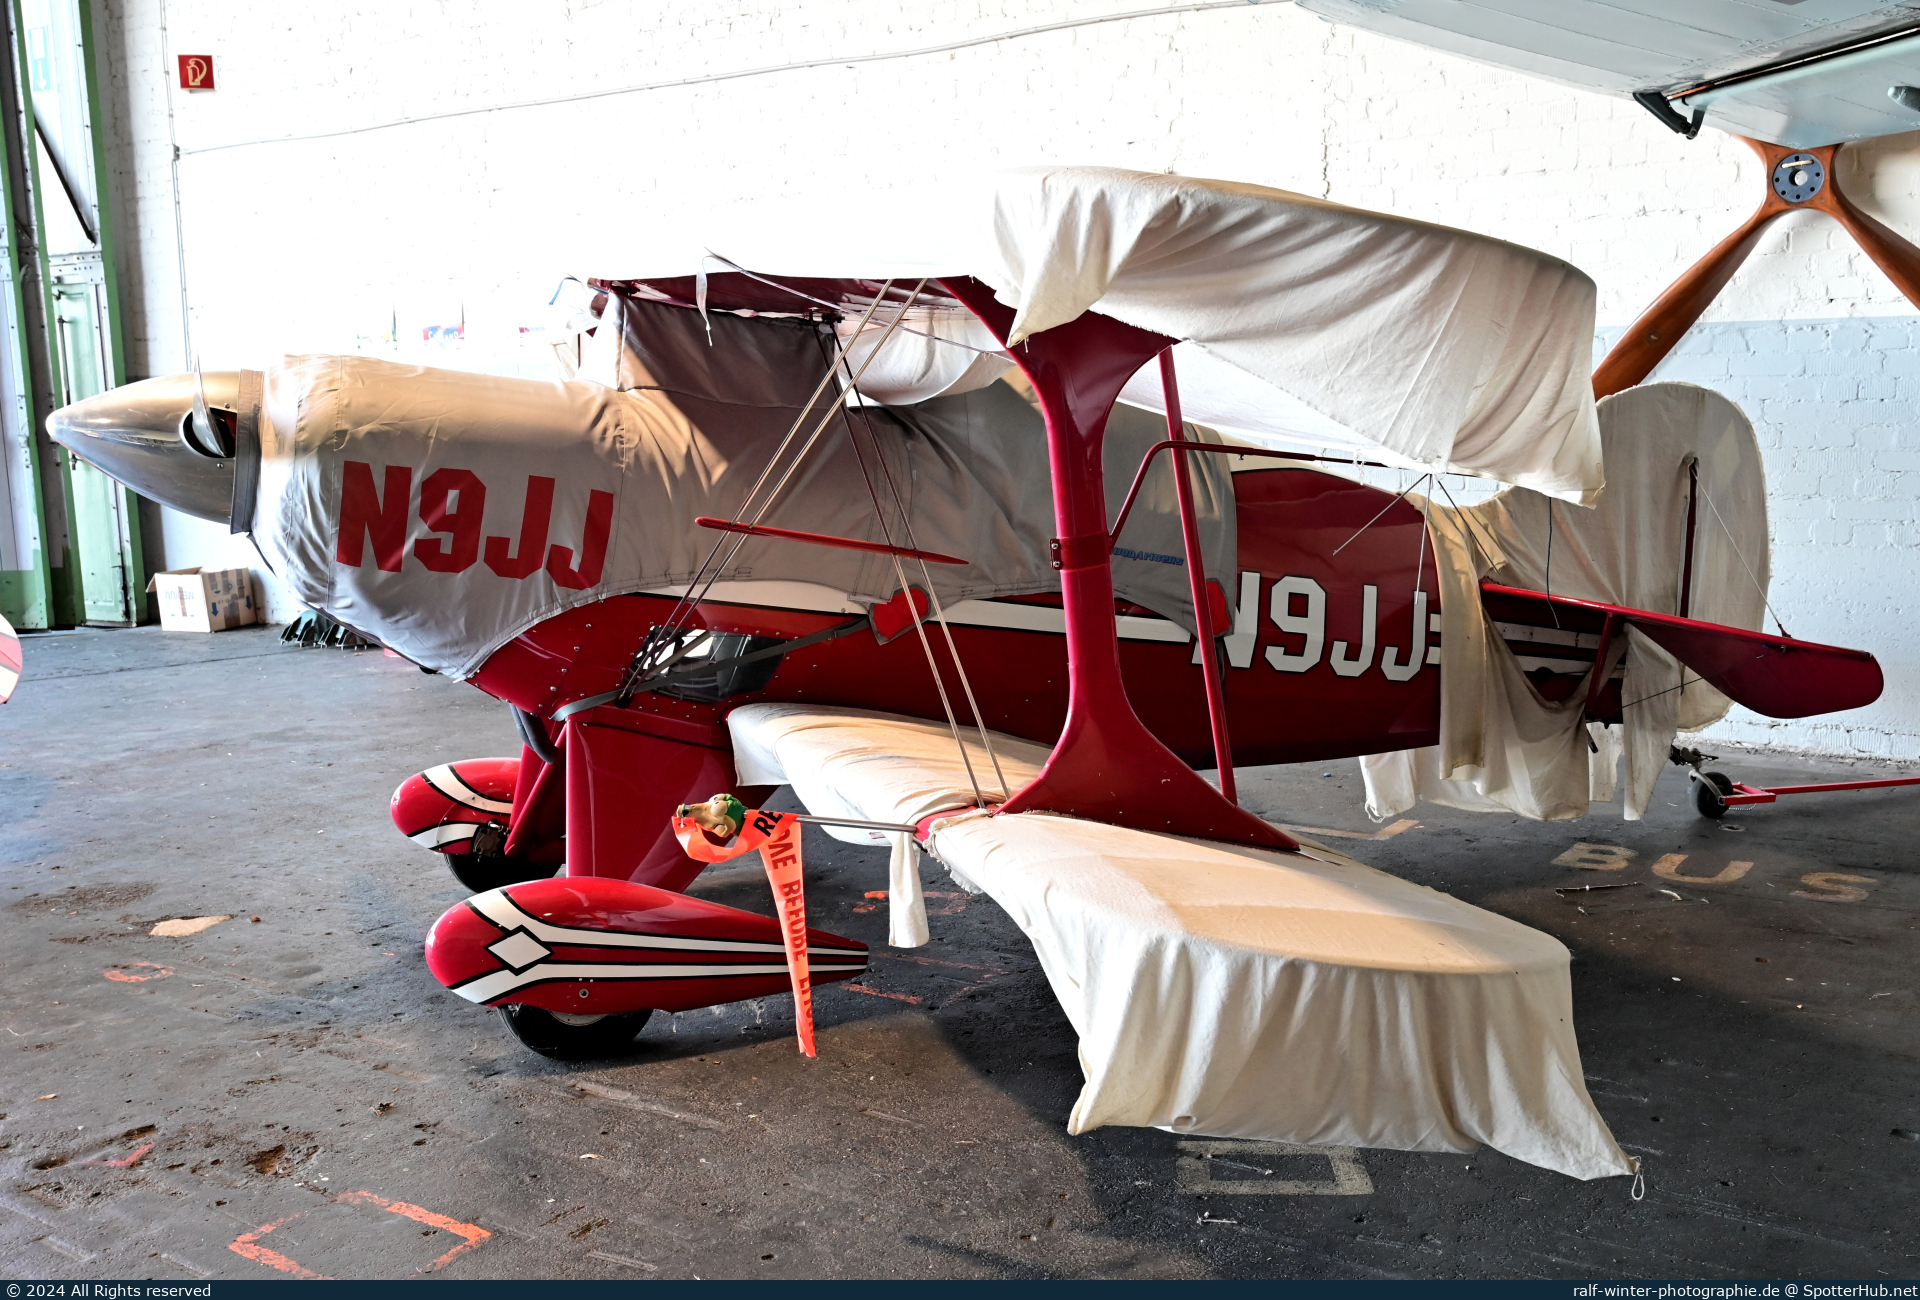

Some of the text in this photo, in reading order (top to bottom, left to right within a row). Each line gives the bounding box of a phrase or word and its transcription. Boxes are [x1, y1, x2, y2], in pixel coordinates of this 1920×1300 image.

[336, 460, 614, 591] N9JJ
[165, 591, 195, 600] MEDIUM
[1191, 571, 1427, 682] N9JJ
[1551, 842, 1877, 901] BUS
